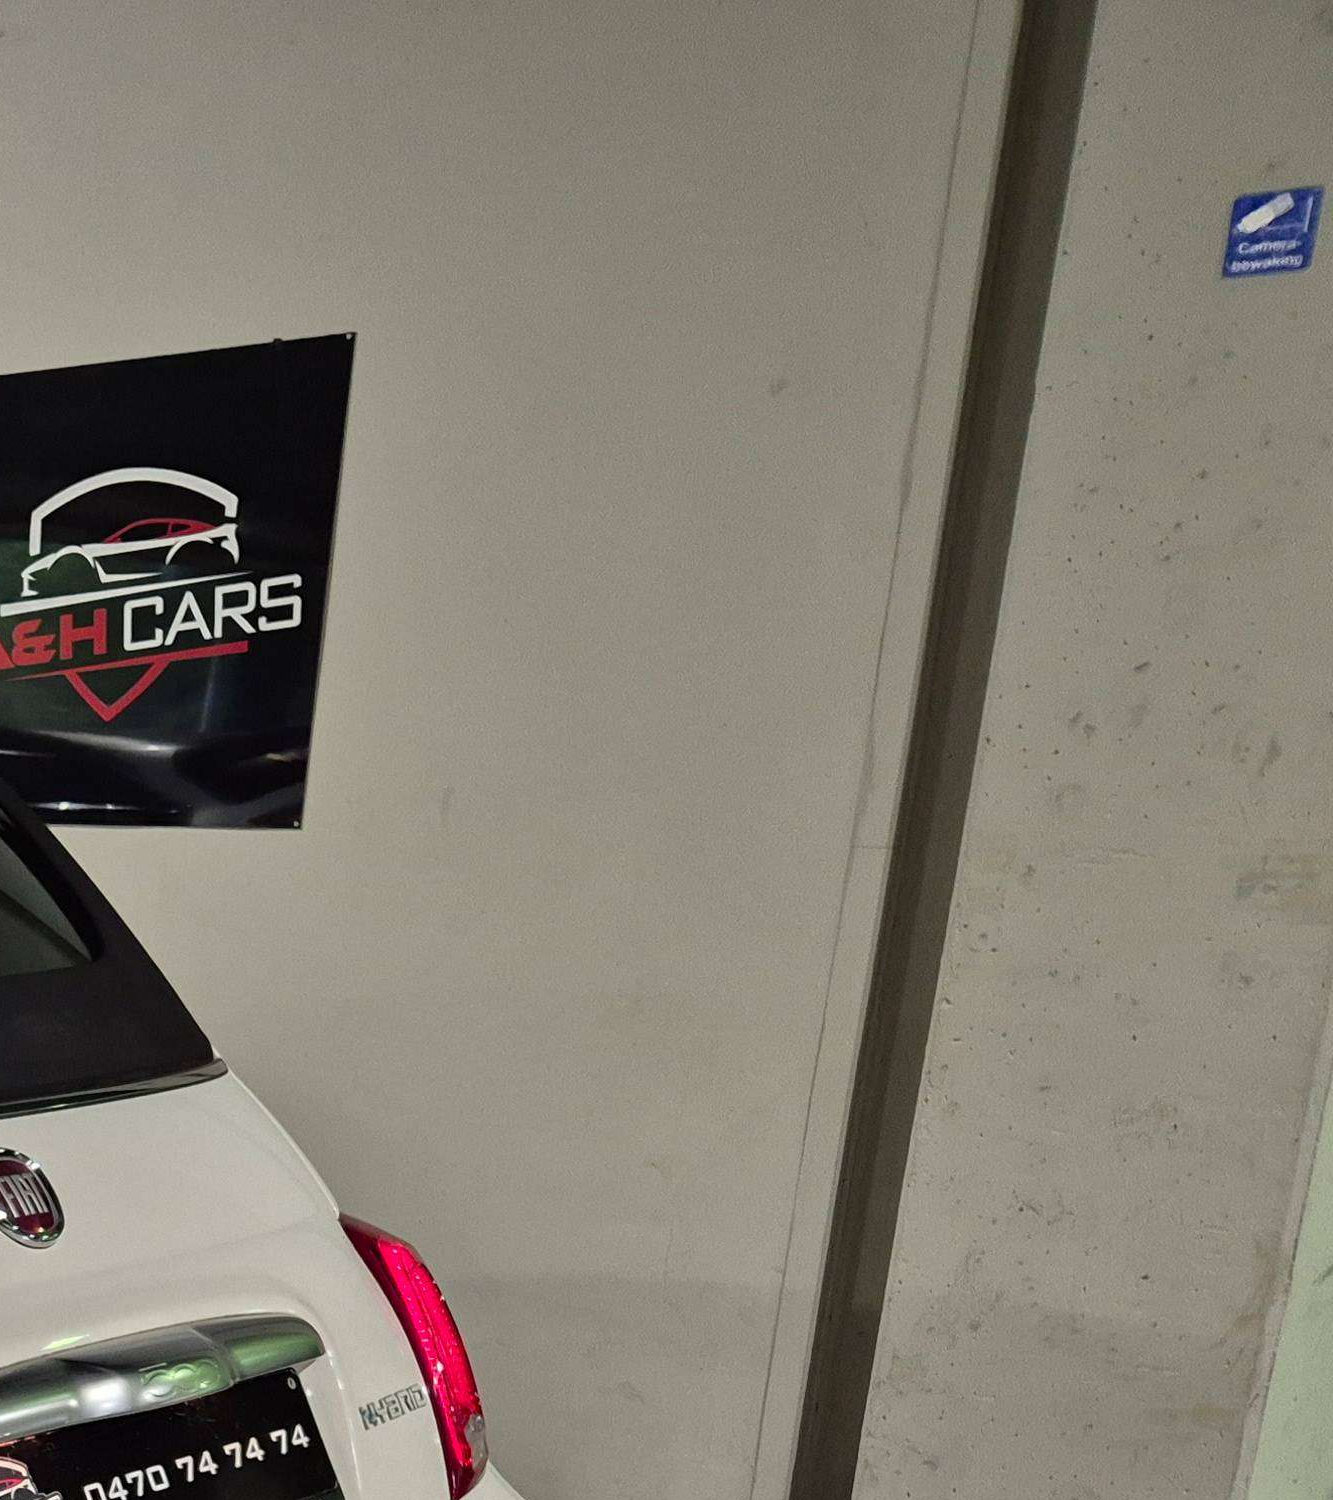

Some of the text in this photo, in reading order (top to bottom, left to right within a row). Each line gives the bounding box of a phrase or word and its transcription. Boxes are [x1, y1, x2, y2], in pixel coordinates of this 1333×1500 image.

[122, 573, 303, 652] CARS
[175, 1450, 219, 1485] 74
[222, 1436, 265, 1469] 74
[270, 1423, 311, 1456] 74
